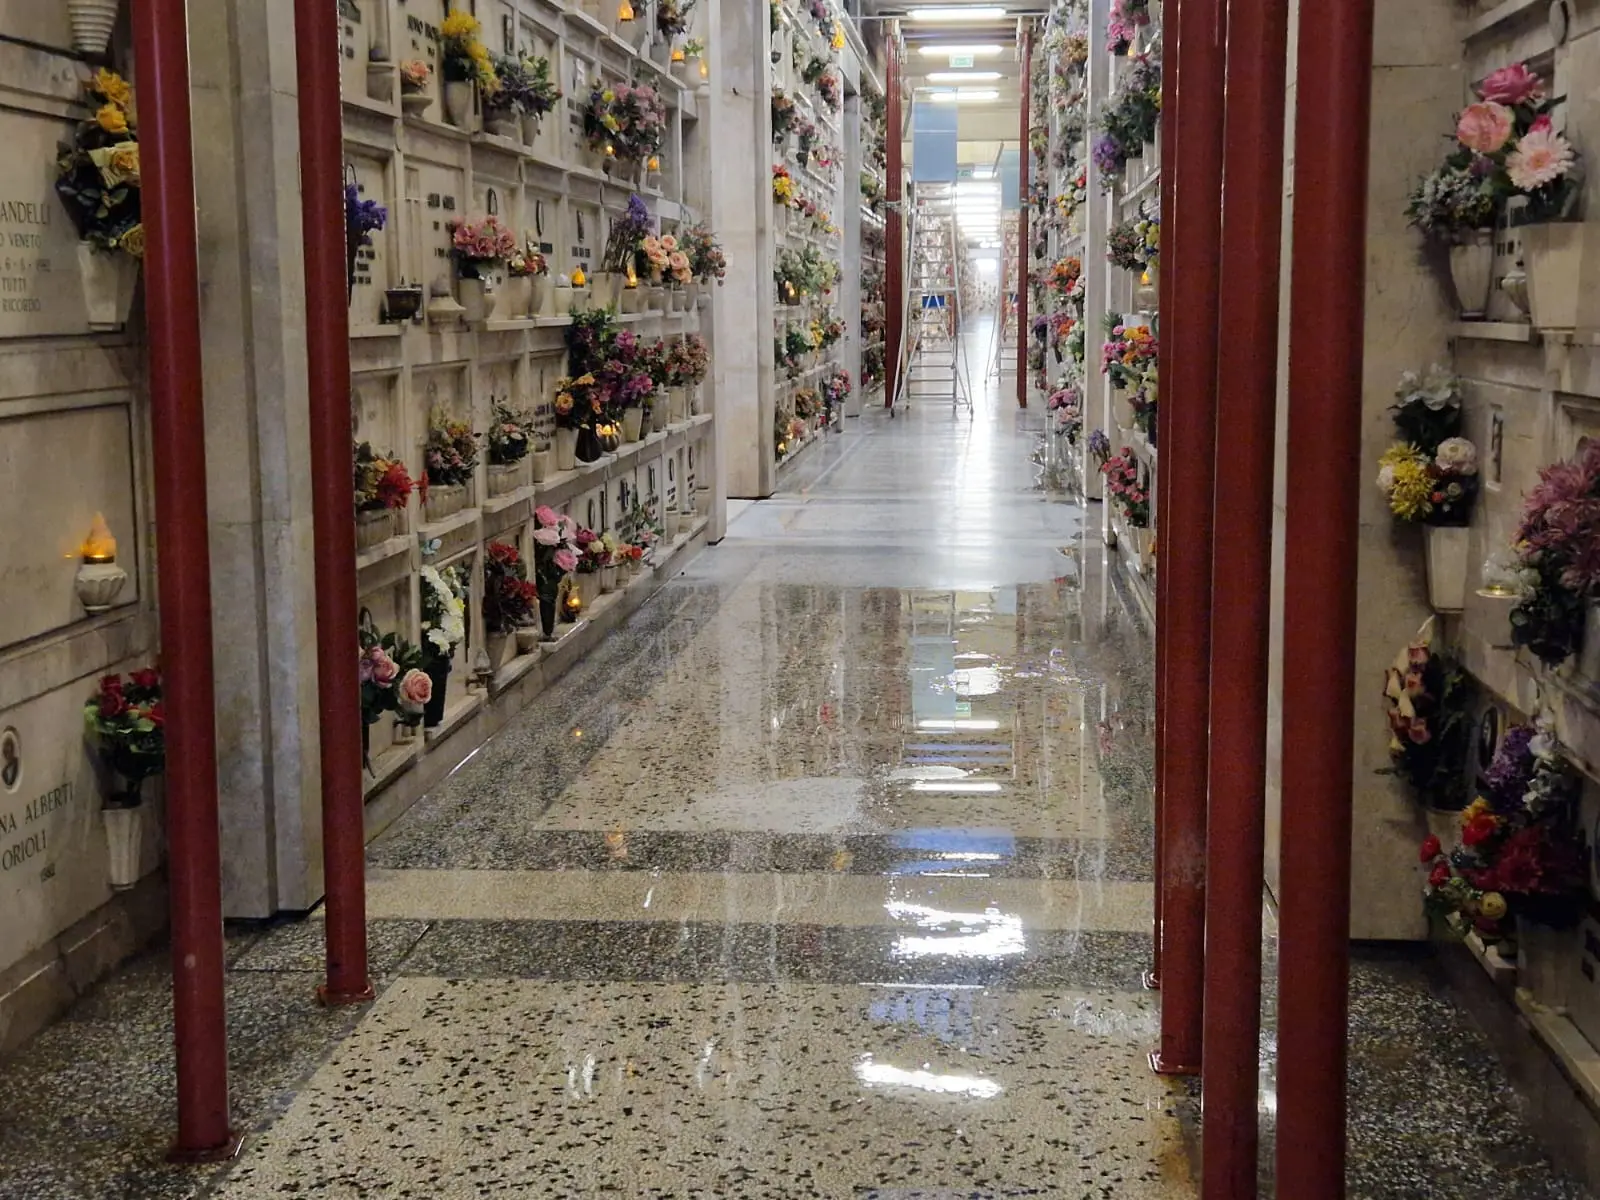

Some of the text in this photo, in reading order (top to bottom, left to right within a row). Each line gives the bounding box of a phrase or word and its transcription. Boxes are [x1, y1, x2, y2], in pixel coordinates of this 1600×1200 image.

[9, 233, 42, 248] VENETO
[2, 277, 26, 292] TUTTI
[2, 298, 41, 312] RICORDO
[25, 781, 73, 824] ALBERTI
[2, 829, 47, 871] ORIOLI
